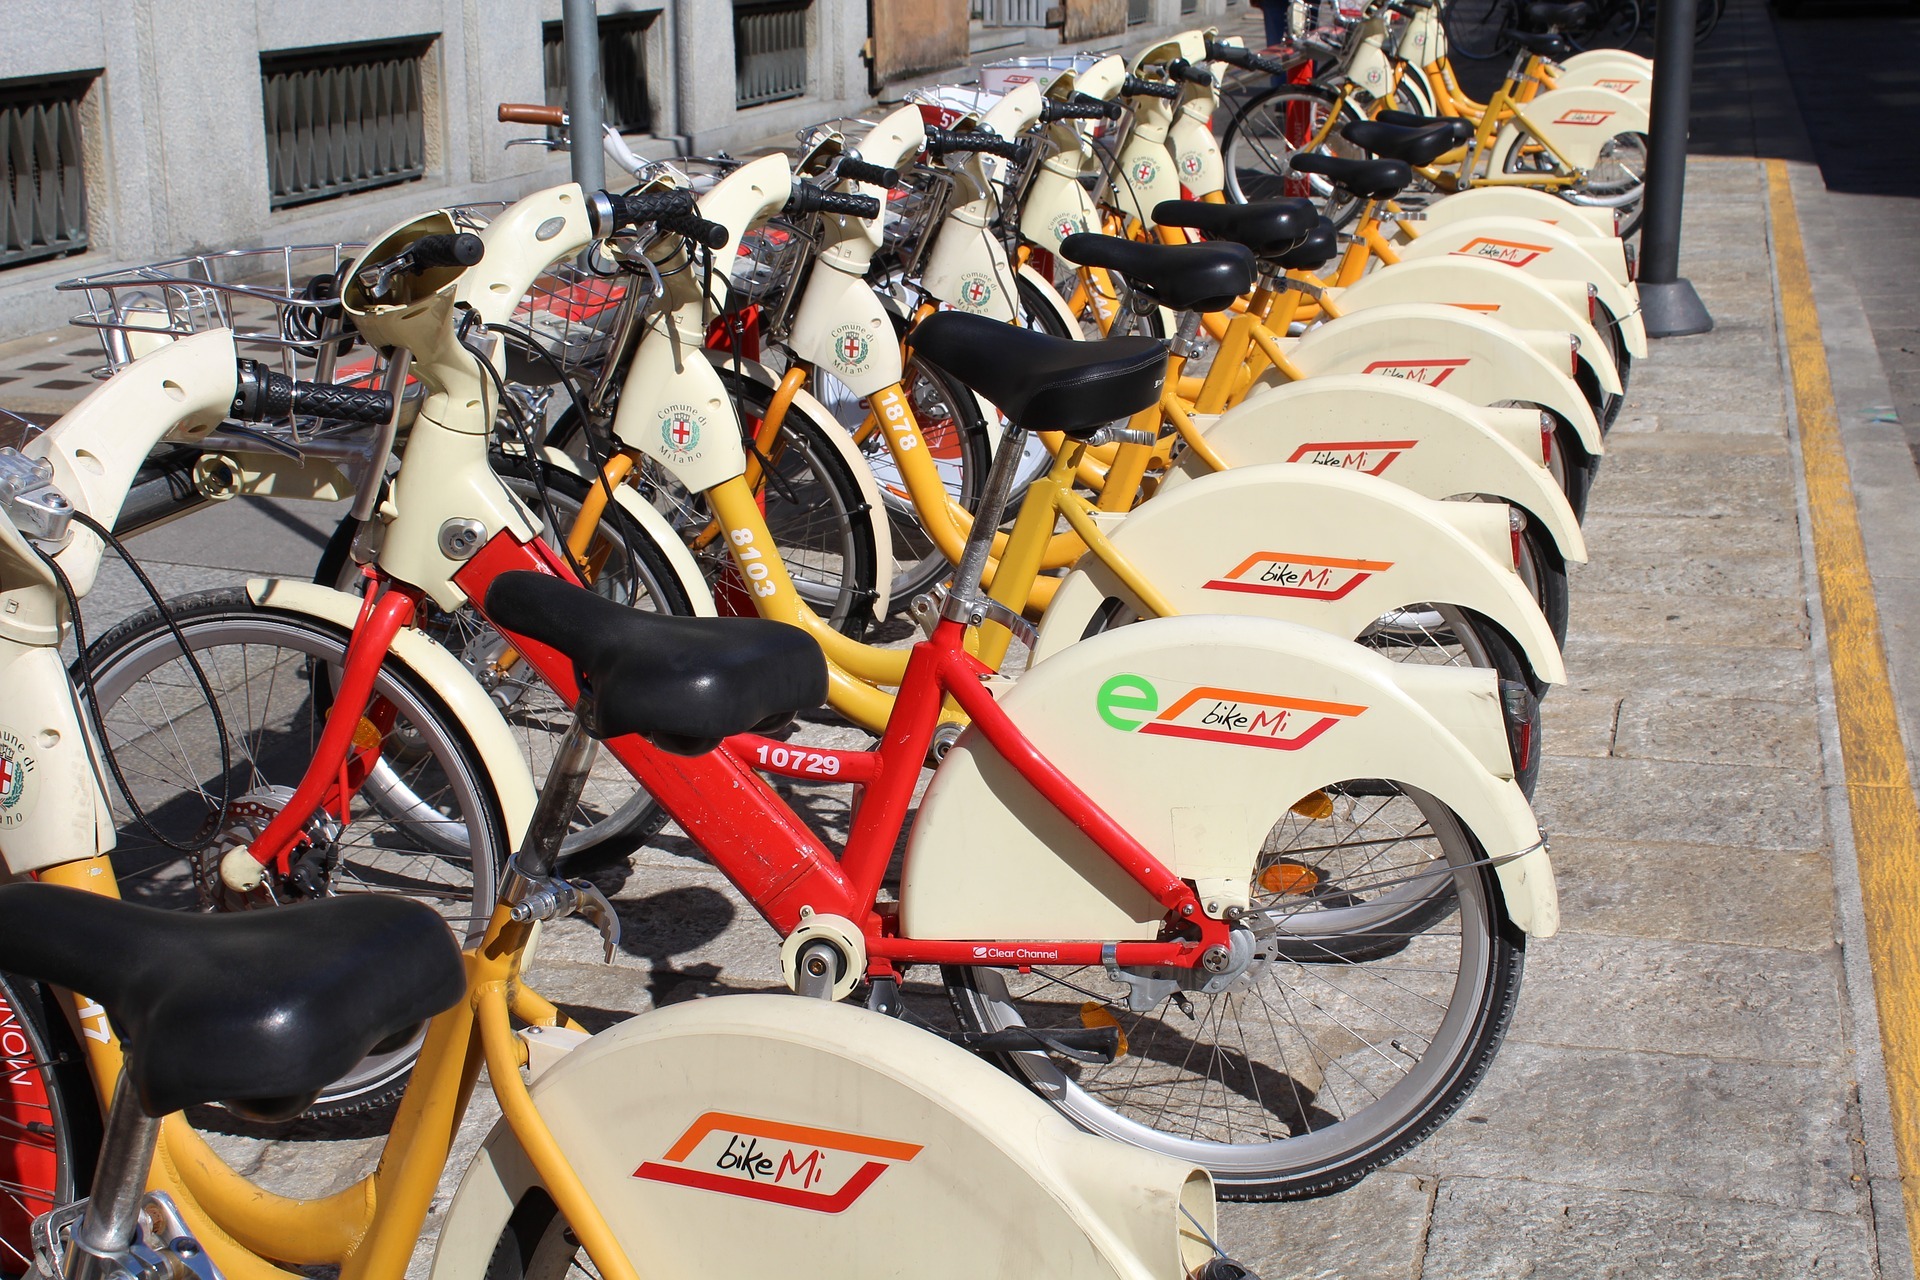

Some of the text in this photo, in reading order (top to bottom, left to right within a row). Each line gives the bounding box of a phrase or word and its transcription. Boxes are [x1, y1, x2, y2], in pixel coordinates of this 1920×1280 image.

[1478, 243, 1519, 261] bikeMi
[960, 271, 993, 282] Comune
[830, 324, 874, 342] Comune di
[831, 359, 870, 374] Milano
[657, 404, 708, 427] Comune di
[881, 391, 918, 452] 1878
[658, 445, 702, 464] Milano
[730, 527, 776, 598] 8103
[1260, 562, 1333, 589] bikeMi
[1096, 673, 1292, 736] e bikeMi
[0, 730, 35, 772] une di
[756, 745, 840, 776] 10729
[988, 948, 1058, 959] Clear Channel
[716, 1134, 827, 1189] bikeMi
